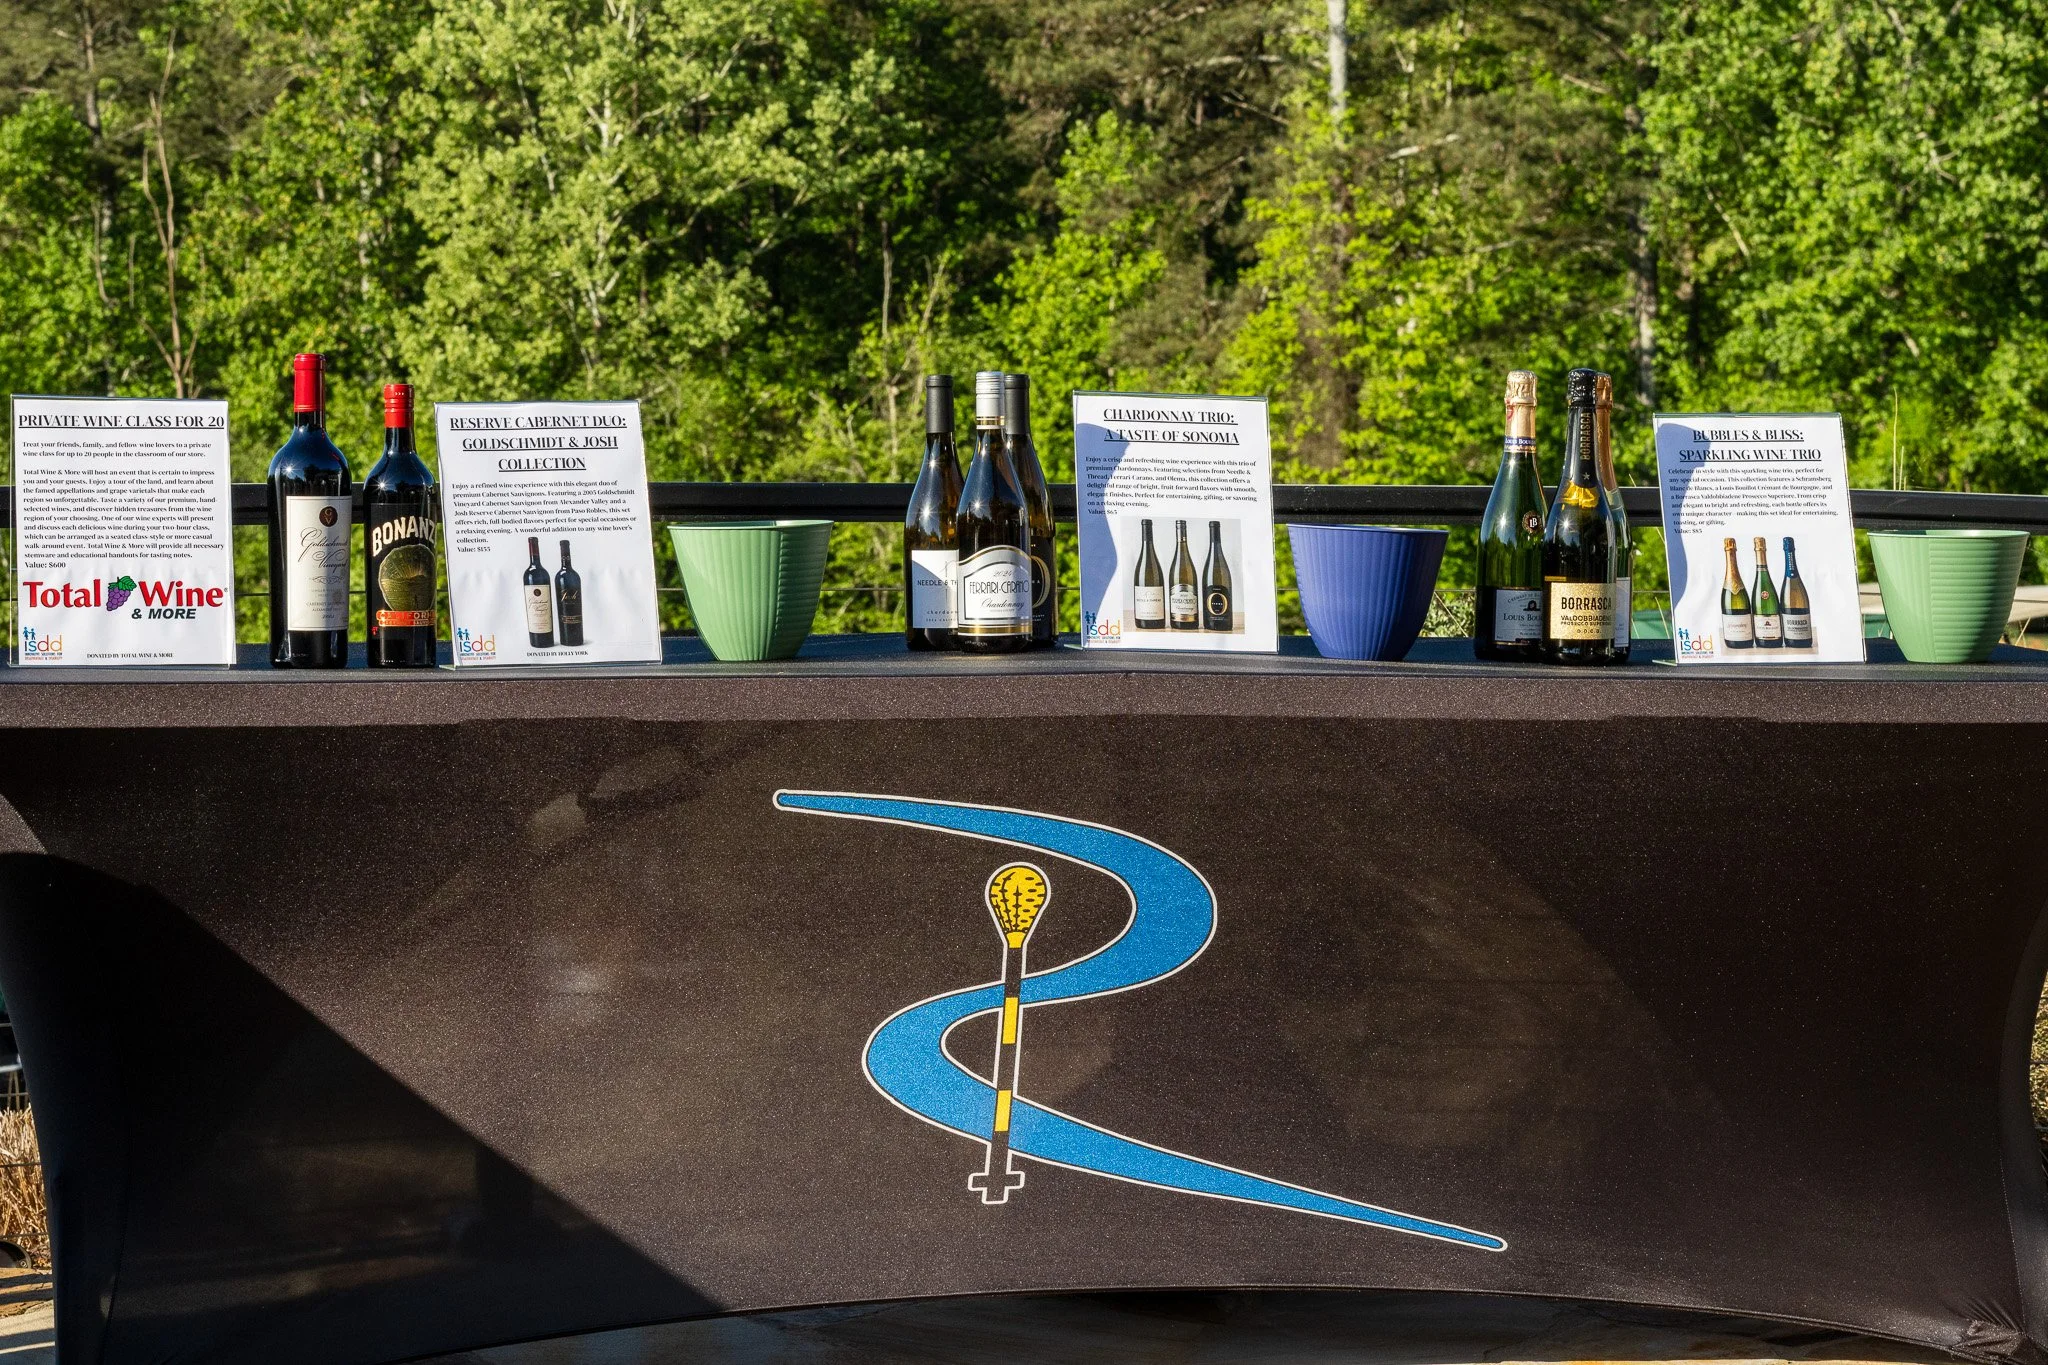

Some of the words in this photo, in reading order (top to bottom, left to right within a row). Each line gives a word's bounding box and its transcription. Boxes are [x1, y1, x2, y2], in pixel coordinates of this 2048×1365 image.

[19, 415, 79, 427] PRIVATE
[83, 415, 122, 427] WINE
[125, 415, 171, 427] CLASS
[175, 415, 203, 427] FOR
[208, 415, 224, 427] 20
[450, 416, 511, 429] RESERVE
[514, 415, 588, 428] CABERNET
[592, 415, 626, 427] DUO:
[1103, 408, 1193, 422] CHARDONNAY
[1198, 411, 1234, 423] TRIO:
[1104, 429, 1114, 440] A
[1116, 429, 1158, 441] TASTE
[1161, 430, 1179, 442] OF
[1182, 431, 1239, 443] SONOMA
[1580, 412, 1591, 461] BORRASCA
[1693, 429, 1748, 441] BUBBLES
[1751, 429, 1761, 440] &
[1765, 429, 1804, 440] BLISS:
[56, 441, 81, 450] friends,
[82, 441, 104, 450] family,
[188, 441, 212, 450] private
[463, 436, 564, 450] GOLDSCHMIDT
[568, 436, 578, 448] &
[583, 435, 618, 448] JOSH
[92, 450, 114, 459] people
[1680, 449, 1750, 461] SPARKLING
[1752, 449, 1787, 460] WINE
[1789, 448, 1821, 460] TRIO
[498, 457, 586, 470] COLLECTION
[1702, 467, 1715, 476] style
[1740, 466, 1767, 476] sparkling
[1781, 466, 1794, 475] trio,
[1794, 466, 1815, 475] perfect
[452, 482, 468, 491] Enjoy
[575, 480, 598, 489] elegant
[1087, 490, 1108, 500] elegant
[1165, 492, 1202, 502] entertaining,
[1203, 493, 1224, 502] gifting,
[372, 516, 435, 557] BONANZ
[150, 551, 172, 560] tasting
[23, 579, 101, 608] Total
[138, 580, 224, 607] Wine
[969, 580, 1029, 594] FERRARI-CARANO
[980, 598, 1024, 610] Chardonnay
[1562, 597, 1612, 610] BORRASCA
[131, 609, 142, 619] &
[148, 609, 196, 619] MORE
